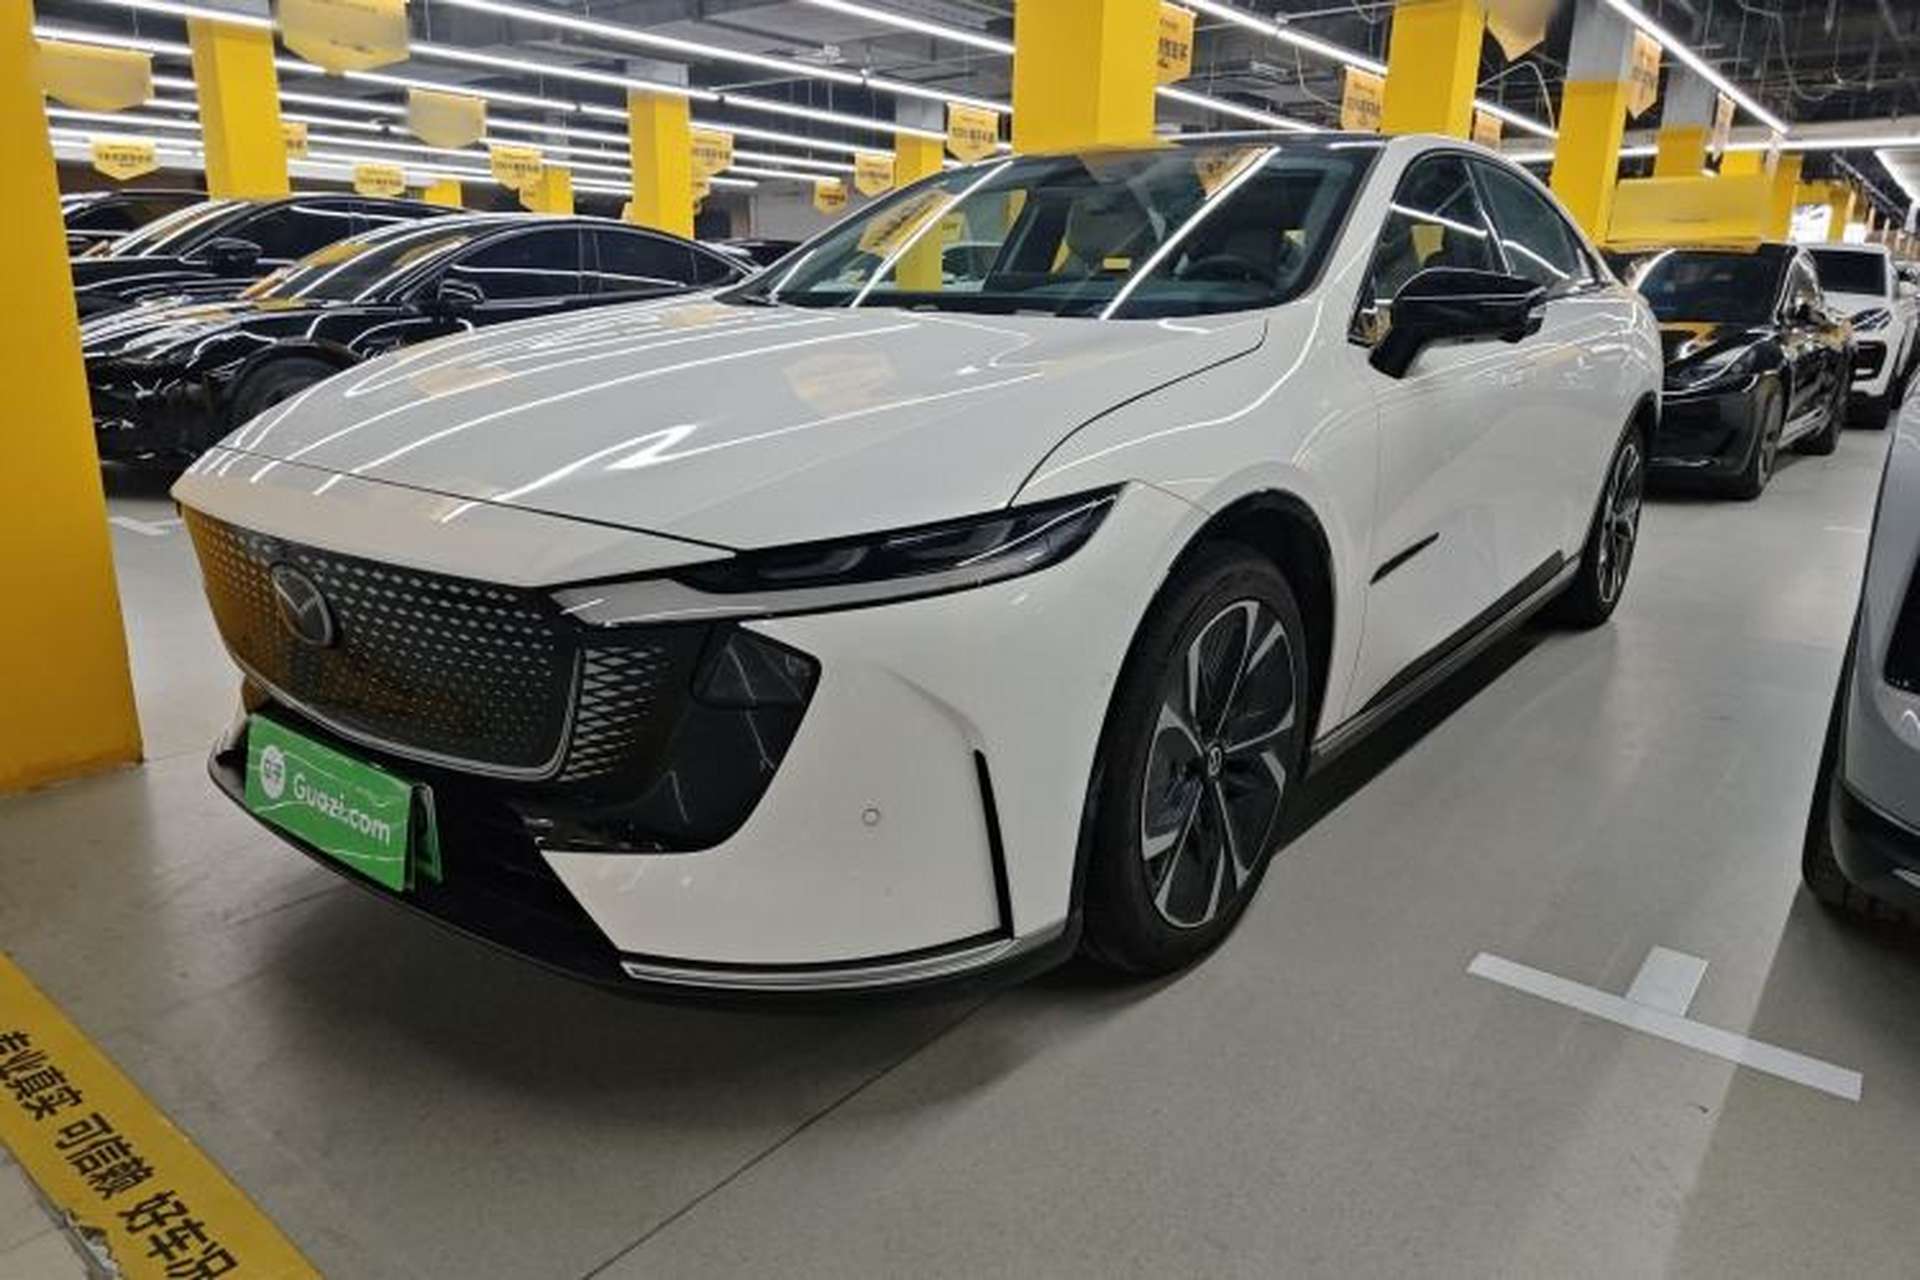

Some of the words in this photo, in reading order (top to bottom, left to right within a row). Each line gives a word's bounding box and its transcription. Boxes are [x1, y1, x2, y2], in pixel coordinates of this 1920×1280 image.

[294, 773, 390, 847] Guazi.com
[55, 1112, 154, 1200] 可信赖
[117, 1190, 238, 1280] 好车况
